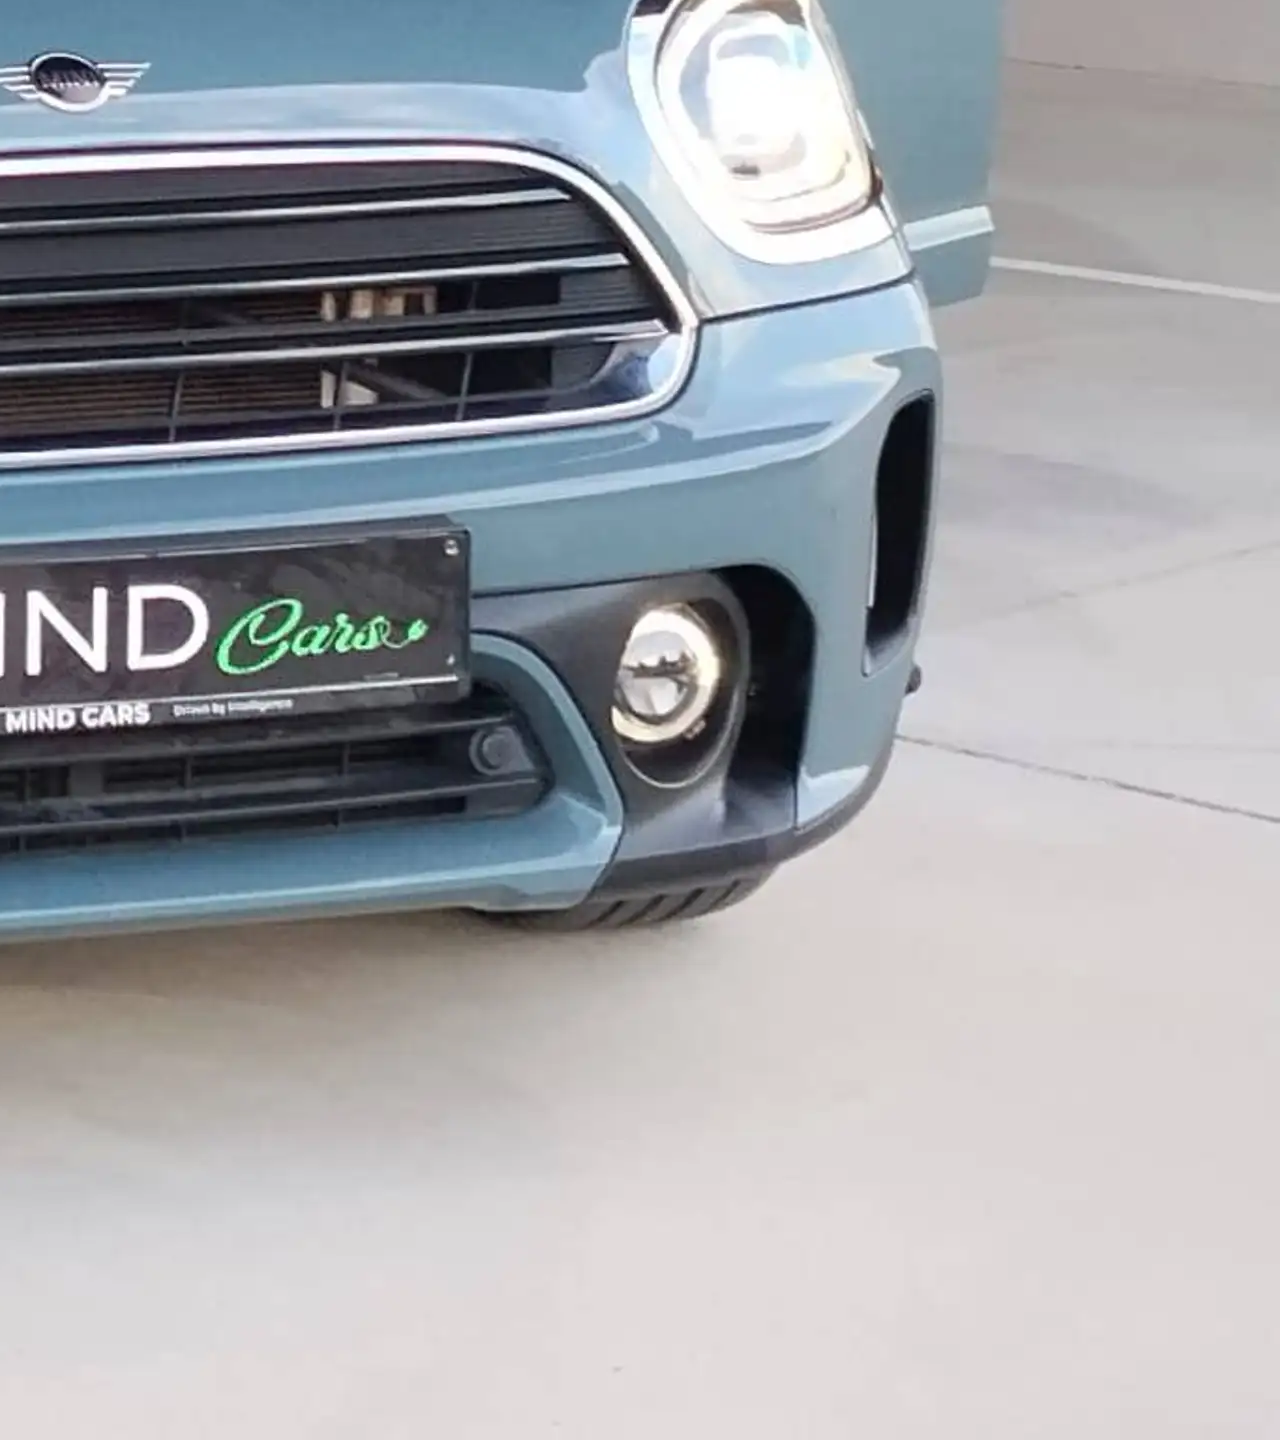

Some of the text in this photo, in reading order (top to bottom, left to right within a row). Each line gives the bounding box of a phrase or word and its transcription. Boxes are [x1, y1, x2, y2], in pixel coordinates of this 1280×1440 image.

[216, 597, 392, 676] Cars
[4, 704, 77, 734] MIND
[80, 702, 152, 728] CARS
